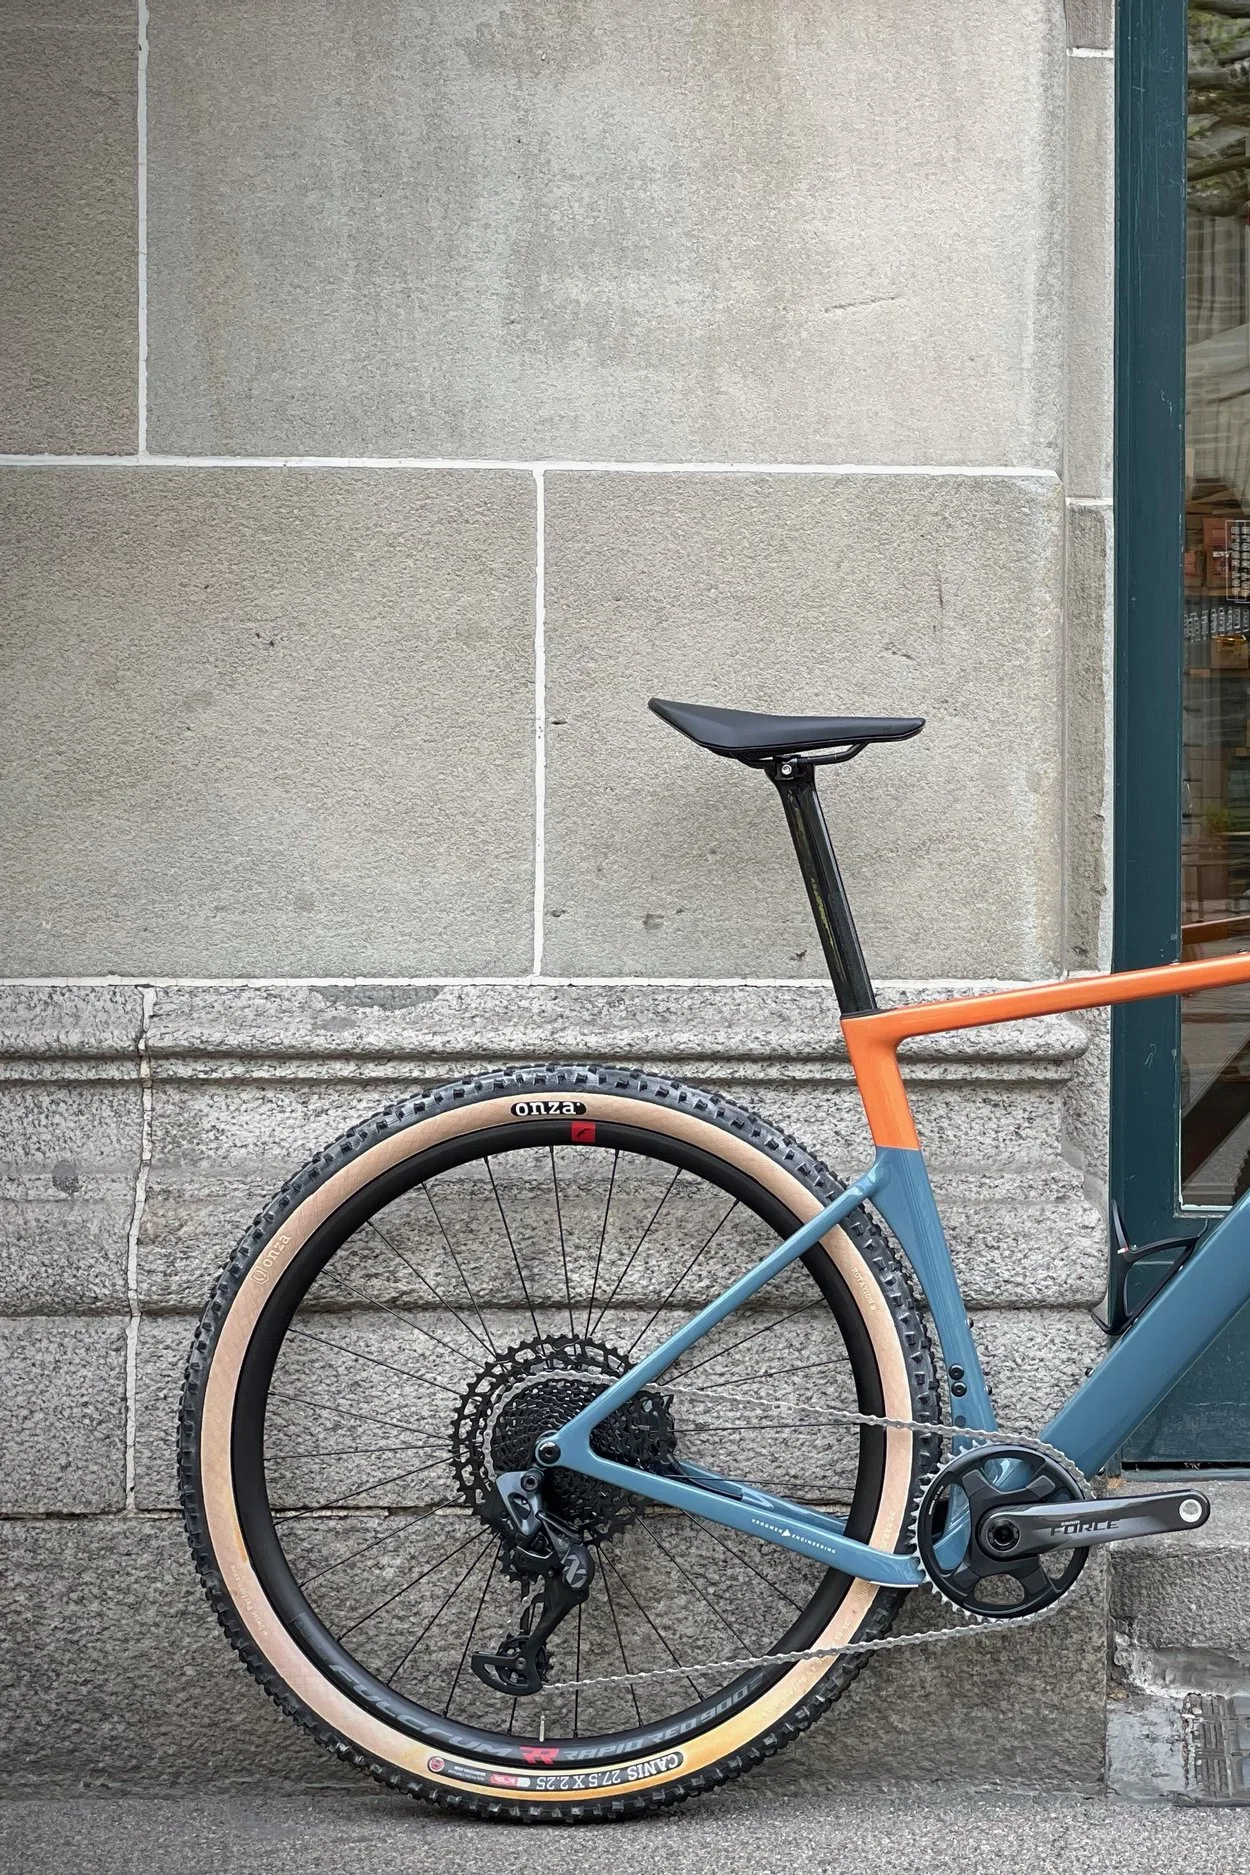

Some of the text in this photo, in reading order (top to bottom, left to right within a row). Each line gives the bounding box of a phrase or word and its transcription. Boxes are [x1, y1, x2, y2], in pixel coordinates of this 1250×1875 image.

[515, 1101, 577, 1116] onza
[263, 1235, 291, 1267] onza
[1050, 1520, 1119, 1536] FORCE
[563, 1738, 644, 1761] RAPID
[648, 1717, 697, 1744] RED
[700, 1684, 748, 1724] 900
[627, 1753, 679, 1781] CANIS
[536, 1776, 570, 1790] 2.25
[572, 1776, 585, 1790] X
[586, 1769, 621, 1788] 27.5
